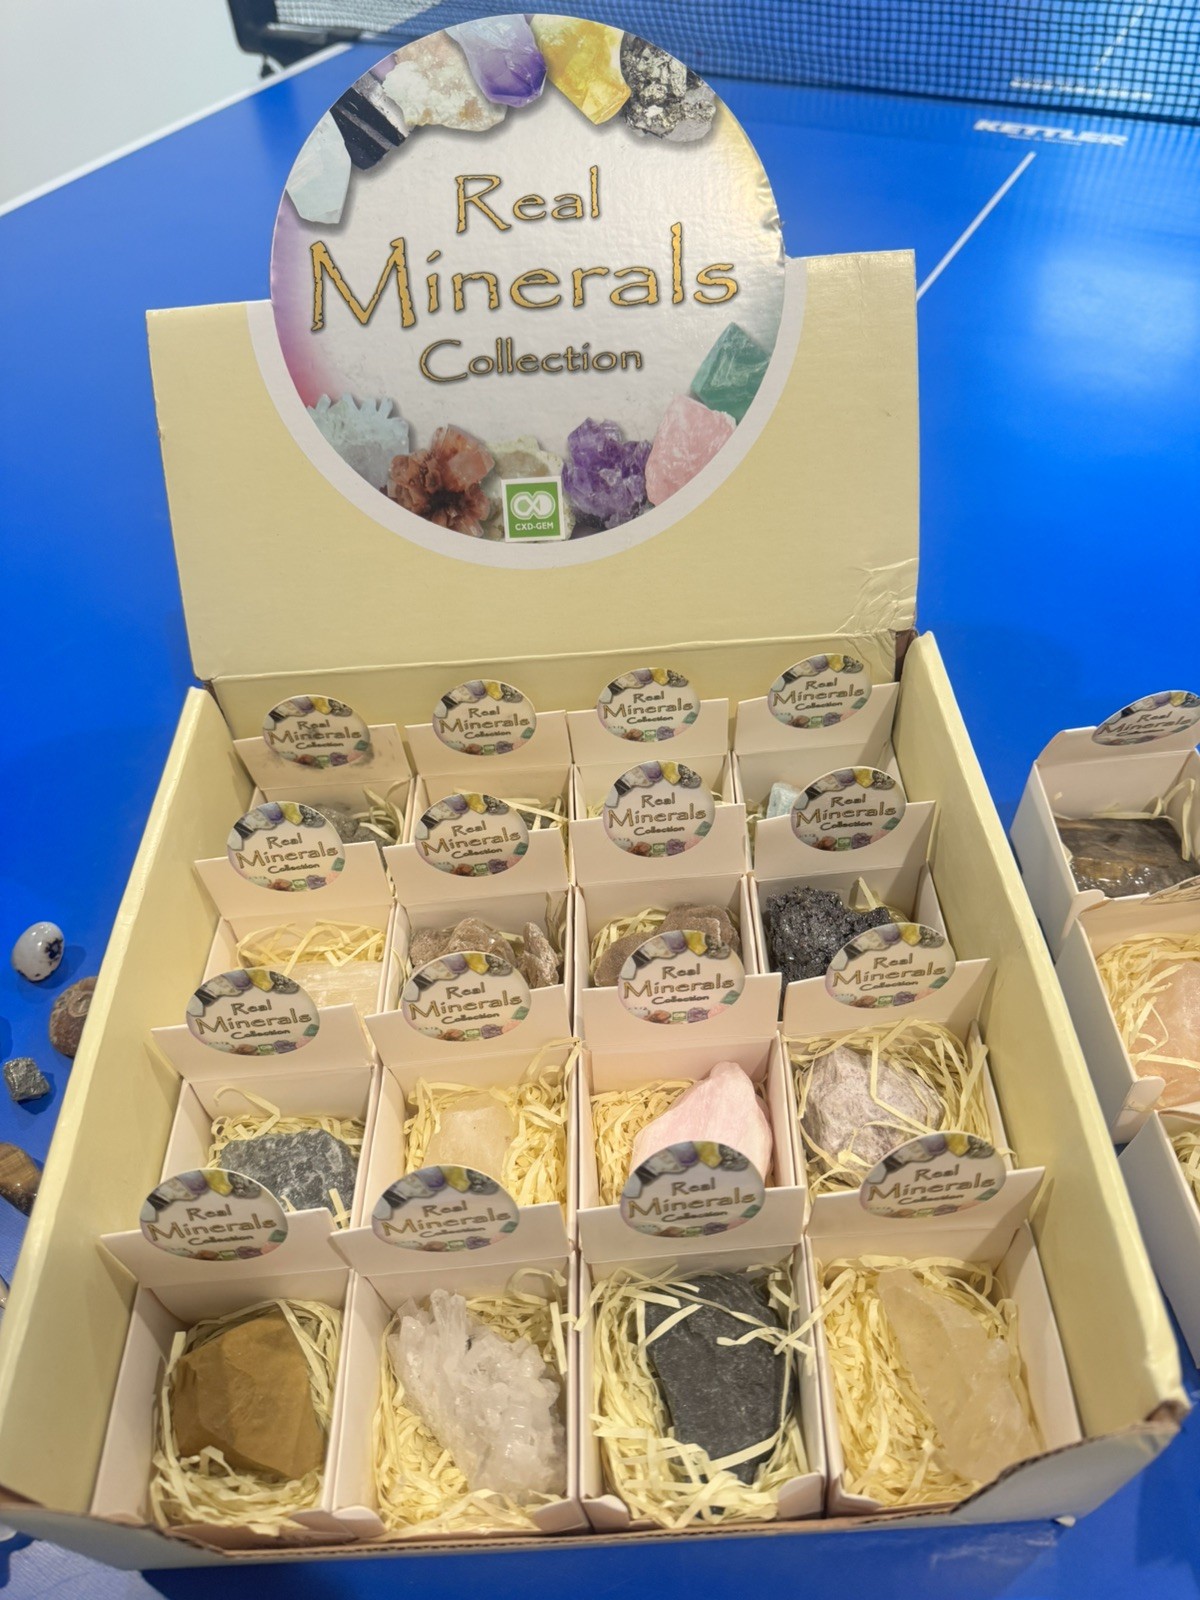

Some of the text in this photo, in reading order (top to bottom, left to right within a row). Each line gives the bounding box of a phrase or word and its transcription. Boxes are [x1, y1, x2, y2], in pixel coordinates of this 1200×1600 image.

[974, 119, 1128, 146] KETTLER
[456, 166, 603, 232] Real
[309, 222, 739, 330] Minerals
[420, 337, 644, 383] Collection
[515, 522, 554, 531] CXD-GEM
[806, 678, 837, 690] Real
[633, 691, 665, 703] Real
[773, 684, 864, 706] Minerals
[468, 706, 500, 718] Real
[603, 699, 693, 718] Minerals
[297, 720, 330, 730] Real
[439, 714, 530, 734] Minerals
[268, 727, 362, 745] Minerals
[642, 793, 675, 808] Real
[830, 794, 866, 807] Real
[609, 803, 706, 828] Minerals
[796, 800, 896, 827] Minerals
[451, 821, 487, 836] Real
[634, 825, 685, 836] Collection
[820, 820, 872, 831] Collection
[267, 833, 303, 849] Real
[422, 827, 521, 856] Minerals
[236, 842, 338, 868] Minerals
[268, 862, 320, 874] Collection
[873, 954, 913, 969] Real
[662, 964, 700, 979] Real
[833, 962, 946, 987] Minerals
[446, 982, 485, 999] Real
[624, 974, 734, 999] Minerals
[231, 1000, 272, 1015] Real
[410, 991, 522, 1019] Minerals
[195, 1009, 311, 1035] Minerals
[914, 1164, 959, 1182] Real
[671, 1178, 715, 1195] Real
[868, 1173, 995, 1201] Minerals
[422, 1201, 467, 1217] Real
[629, 1188, 755, 1218] Minerals
[186, 1204, 232, 1221] Real
[149, 1213, 276, 1242] Minerals
[382, 1208, 511, 1236] Minerals
